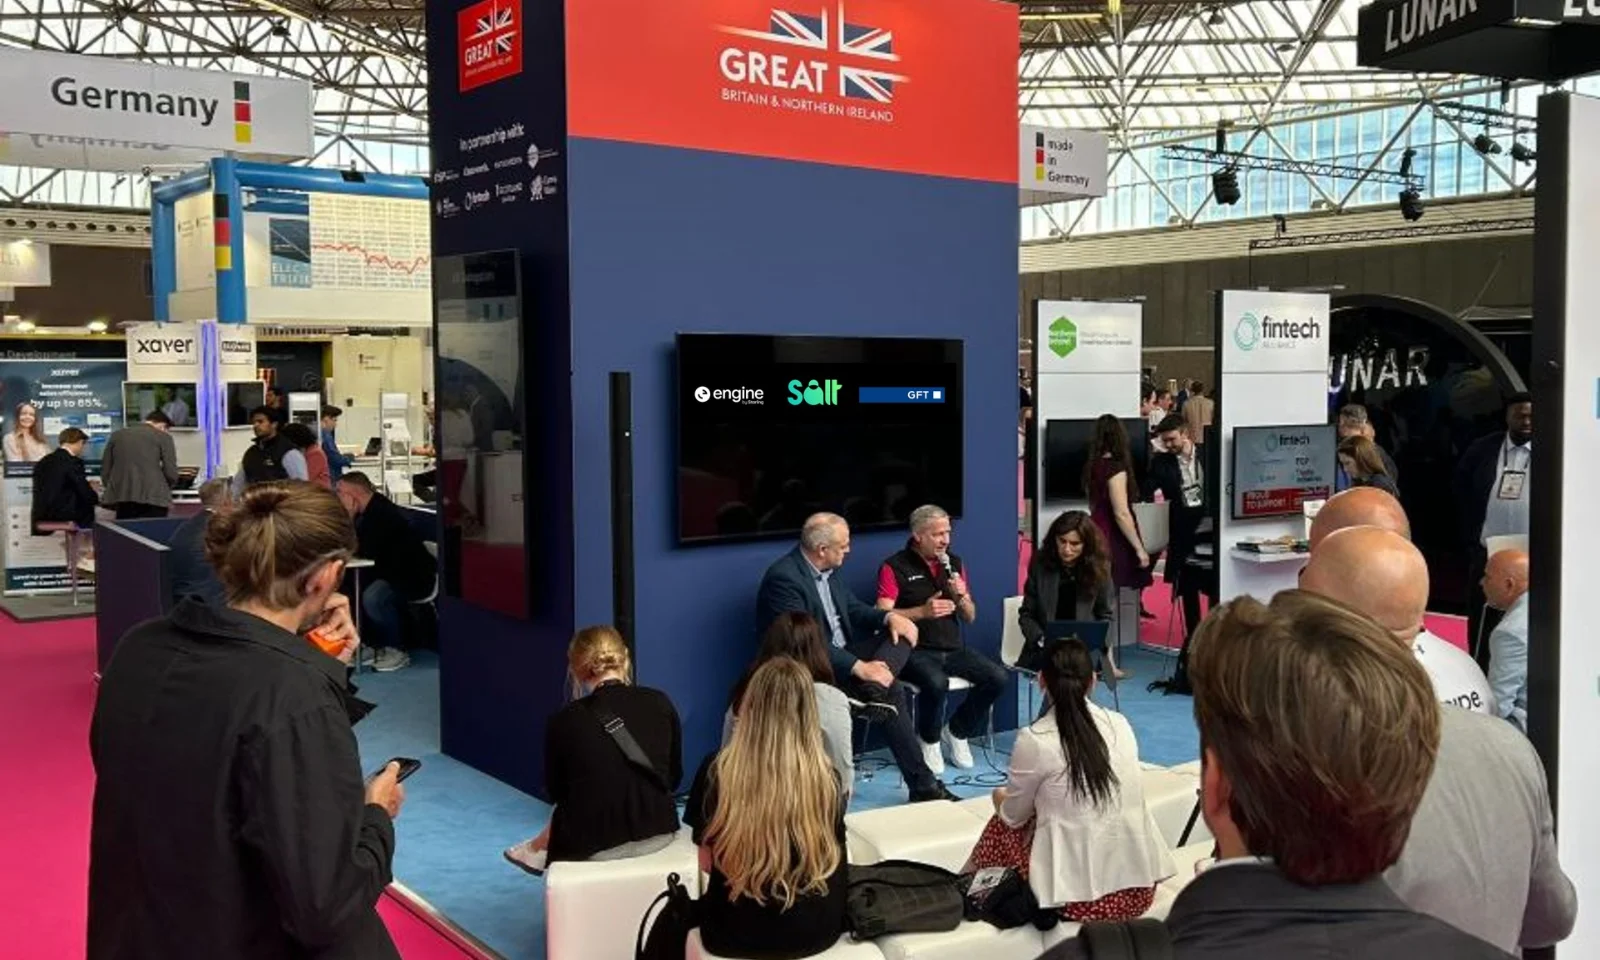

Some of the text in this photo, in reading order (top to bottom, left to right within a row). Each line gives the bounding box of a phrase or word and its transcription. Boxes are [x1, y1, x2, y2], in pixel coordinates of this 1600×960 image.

[464, 39, 494, 67] GREAT
[719, 47, 828, 95] GREAT
[51, 76, 219, 126] Germany
[720, 87, 894, 123] BRITAIN & NORTHERN IRELAND
[1047, 138, 1073, 151] made
[1047, 155, 1057, 166] in
[1047, 171, 1090, 188] Germany
[1261, 315, 1321, 339] fintech
[137, 338, 194, 353] xaver
[1328, 346, 1431, 394] UNAR
[712, 385, 764, 403] engine
[907, 390, 930, 400] GFT
[30, 398, 44, 409] by
[47, 400, 61, 408] up
[1279, 432, 1310, 446] fintech
[1246, 500, 1257, 510] TO
